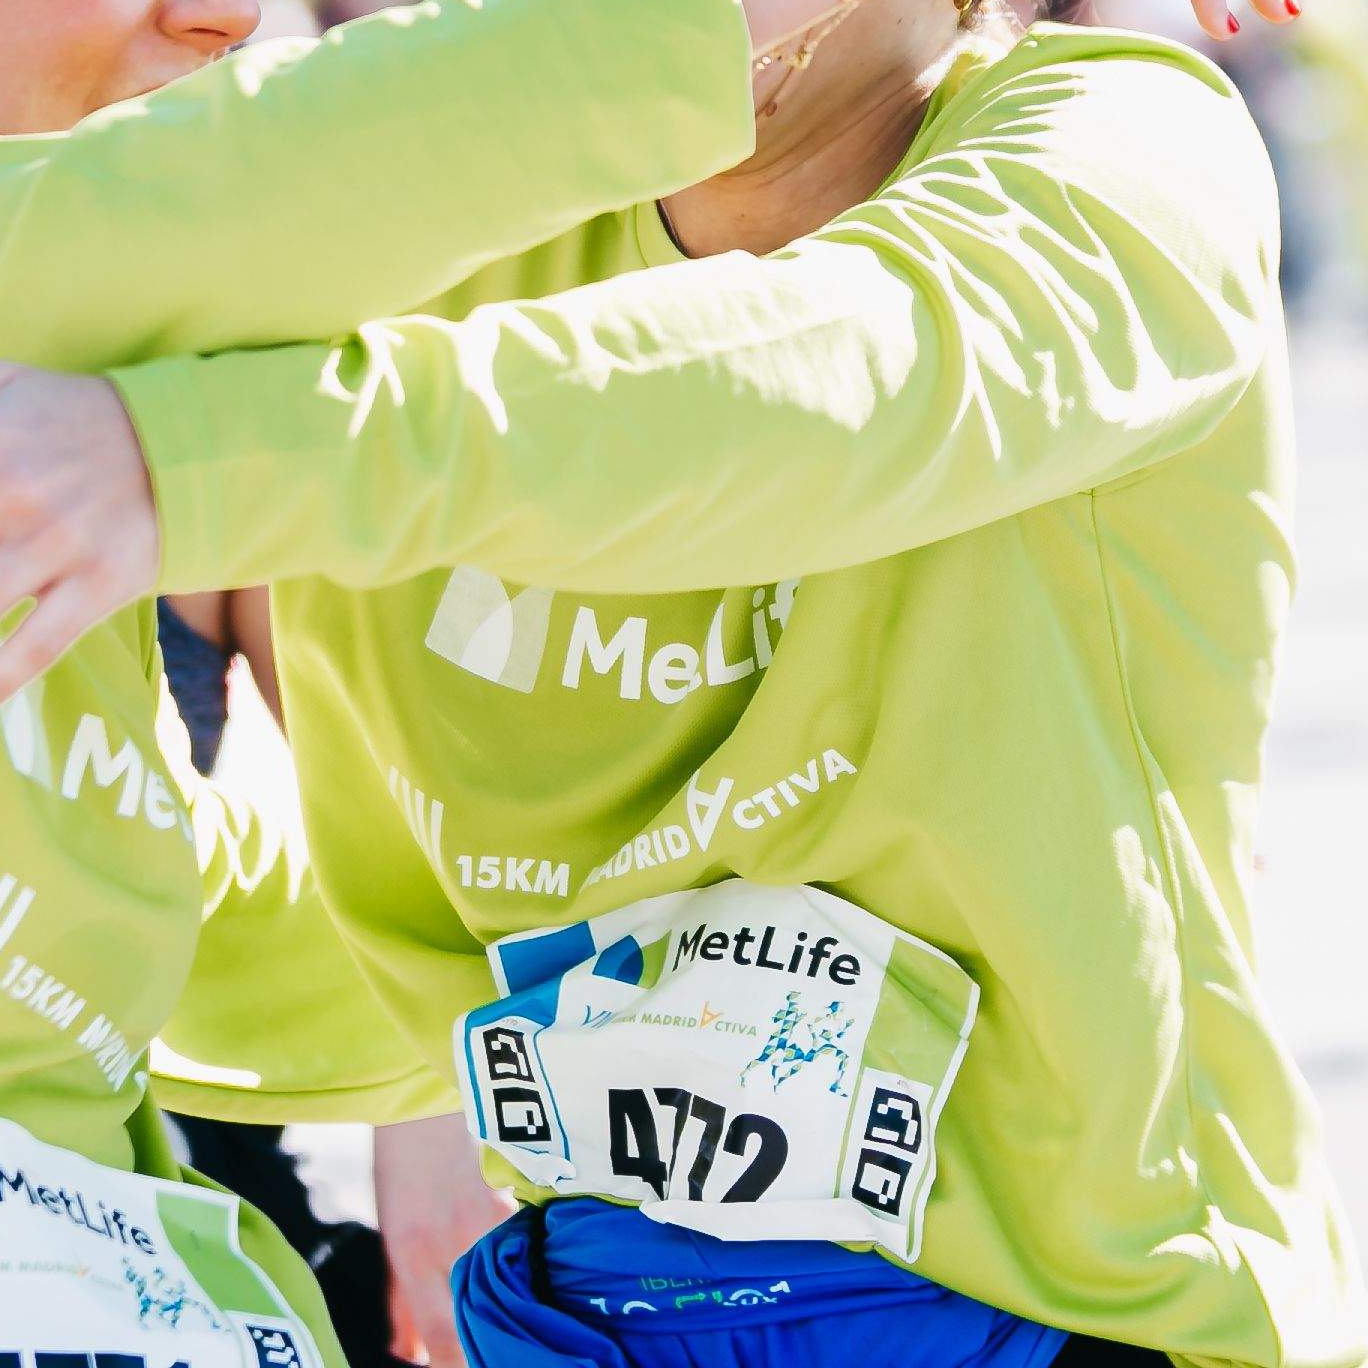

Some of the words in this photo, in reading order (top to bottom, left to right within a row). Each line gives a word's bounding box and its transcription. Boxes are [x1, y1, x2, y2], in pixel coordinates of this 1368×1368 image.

[455, 854, 570, 898] 15KM
[671, 922, 861, 986] MetLife
[640, 1012, 697, 1029] MADRID
